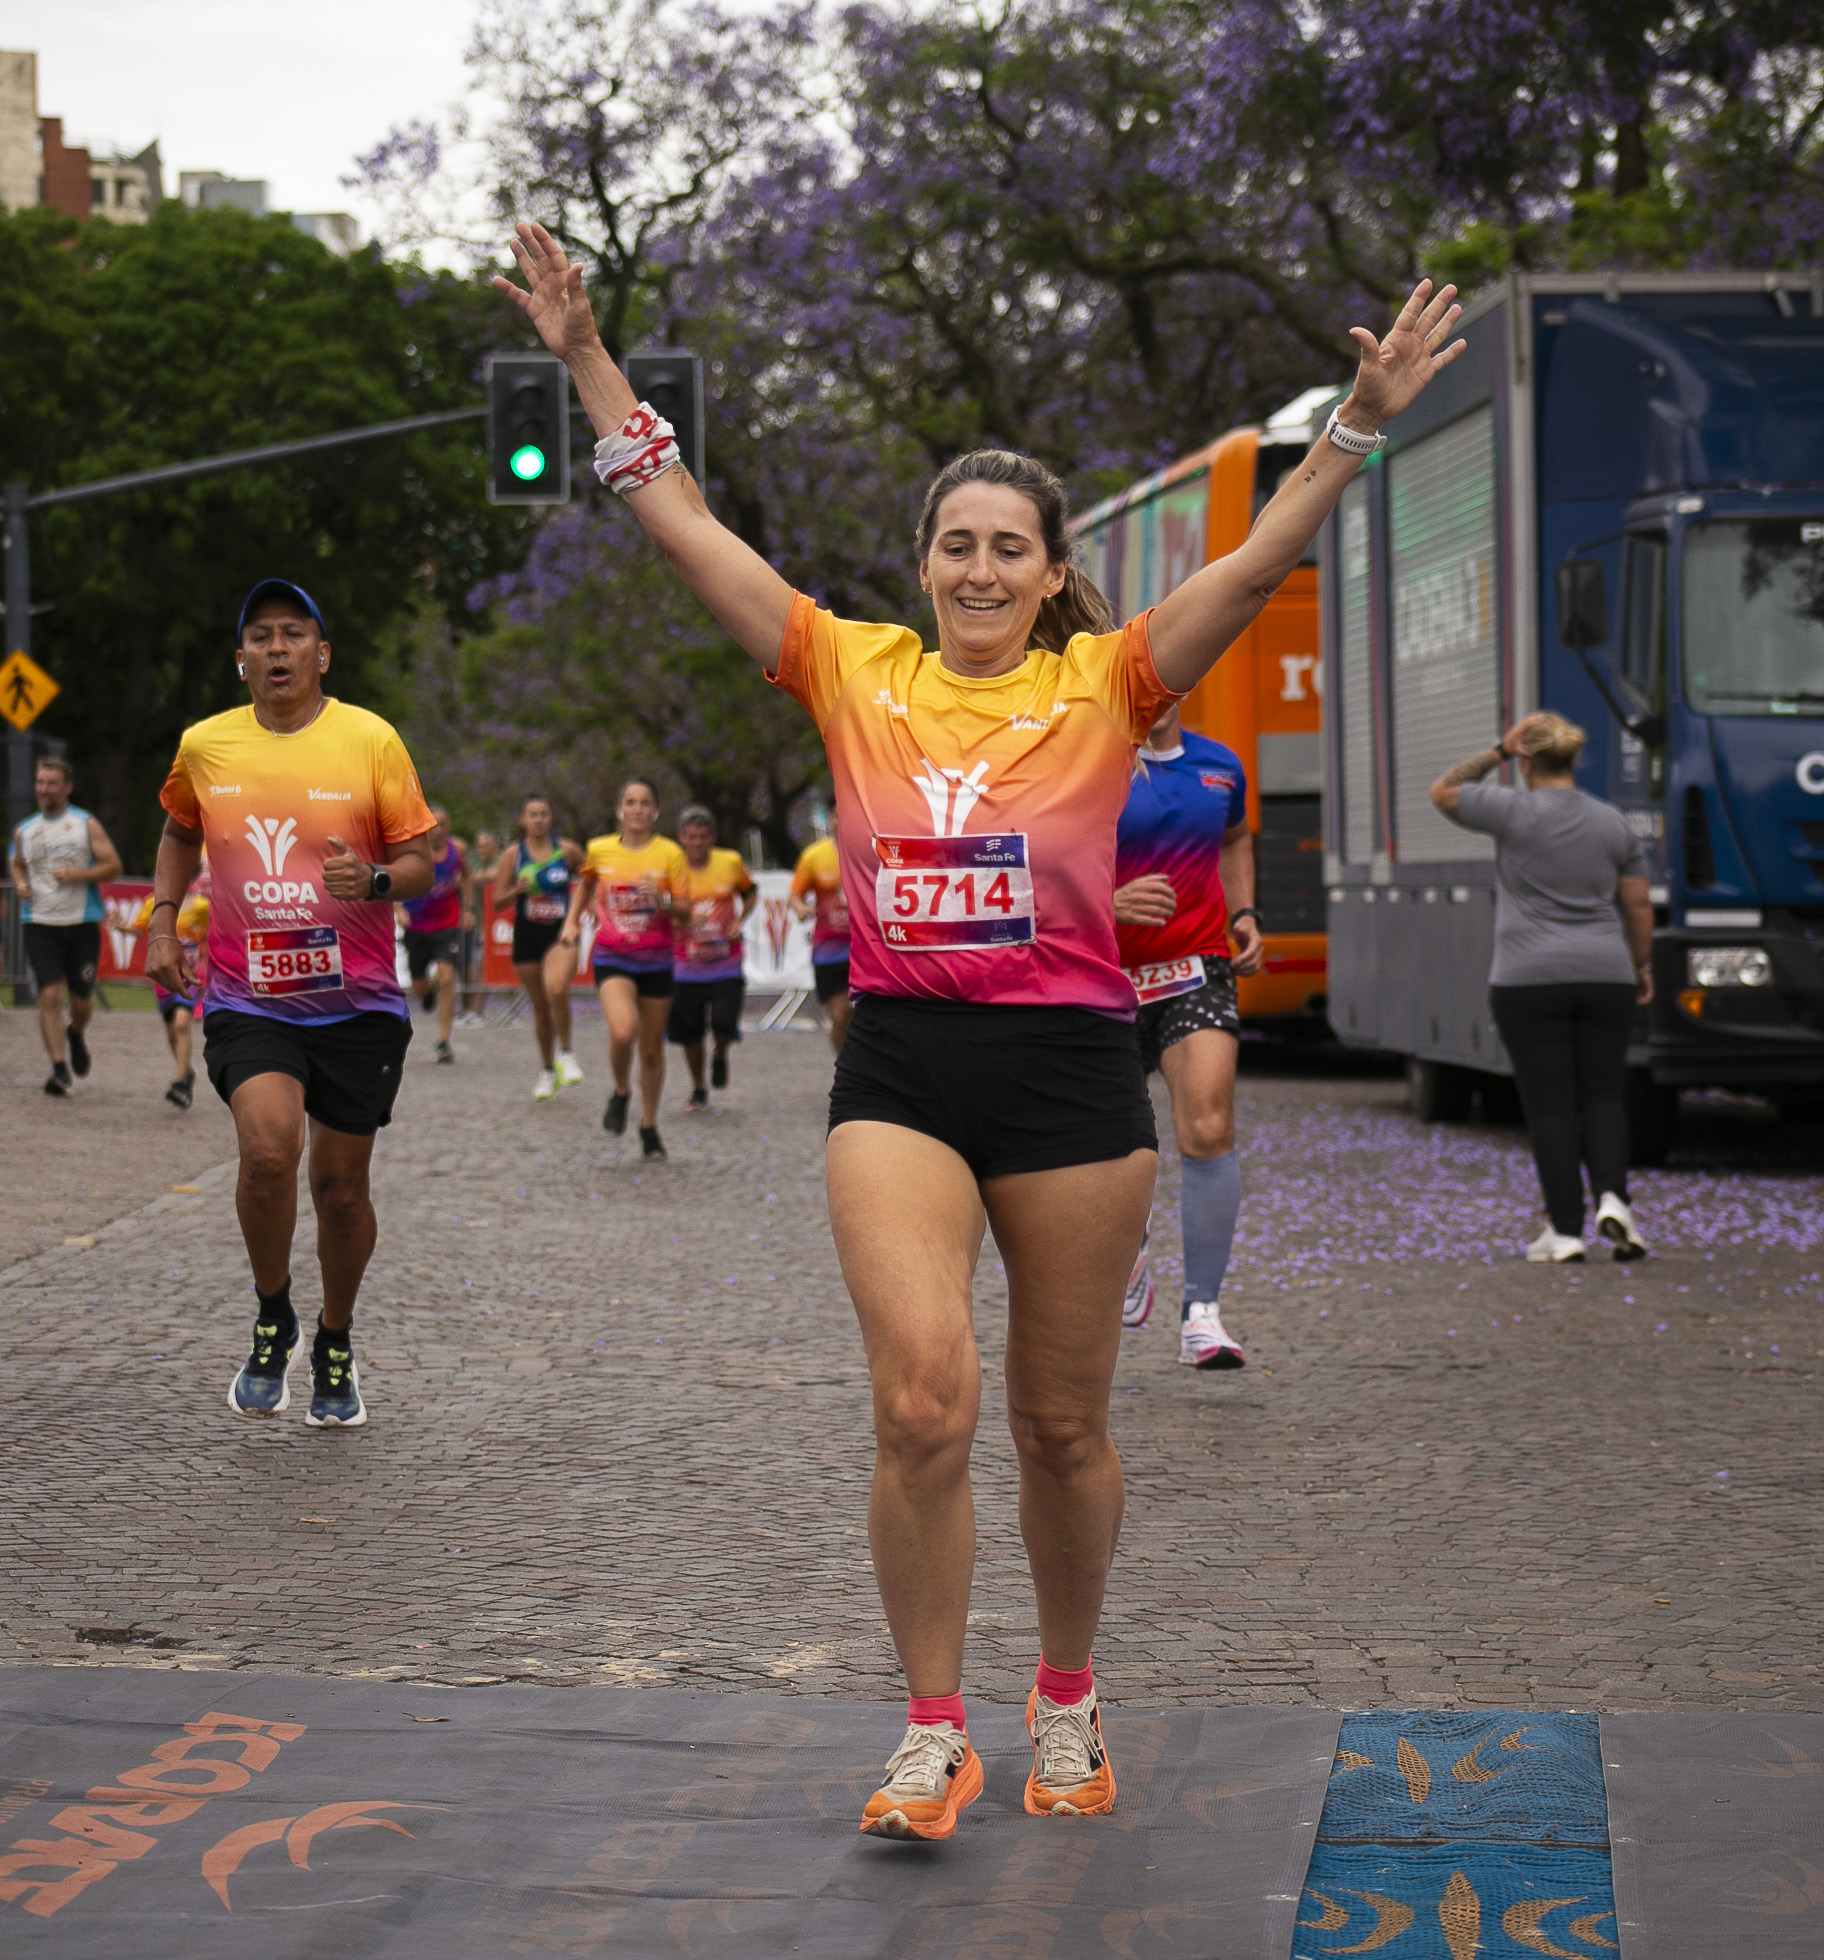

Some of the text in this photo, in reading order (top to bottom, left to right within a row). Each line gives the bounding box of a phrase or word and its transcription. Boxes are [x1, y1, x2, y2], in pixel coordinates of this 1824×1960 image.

[974, 852, 1015, 862] Santa Fe
[244, 881, 320, 904] COPA
[893, 873, 1014, 917] 5714
[255, 907, 313, 920] Santa Fe
[888, 925, 907, 941] 4k
[261, 951, 331, 978] 5883
[1130, 959, 1192, 987] 5239
[257, 984, 270, 992] 4k
